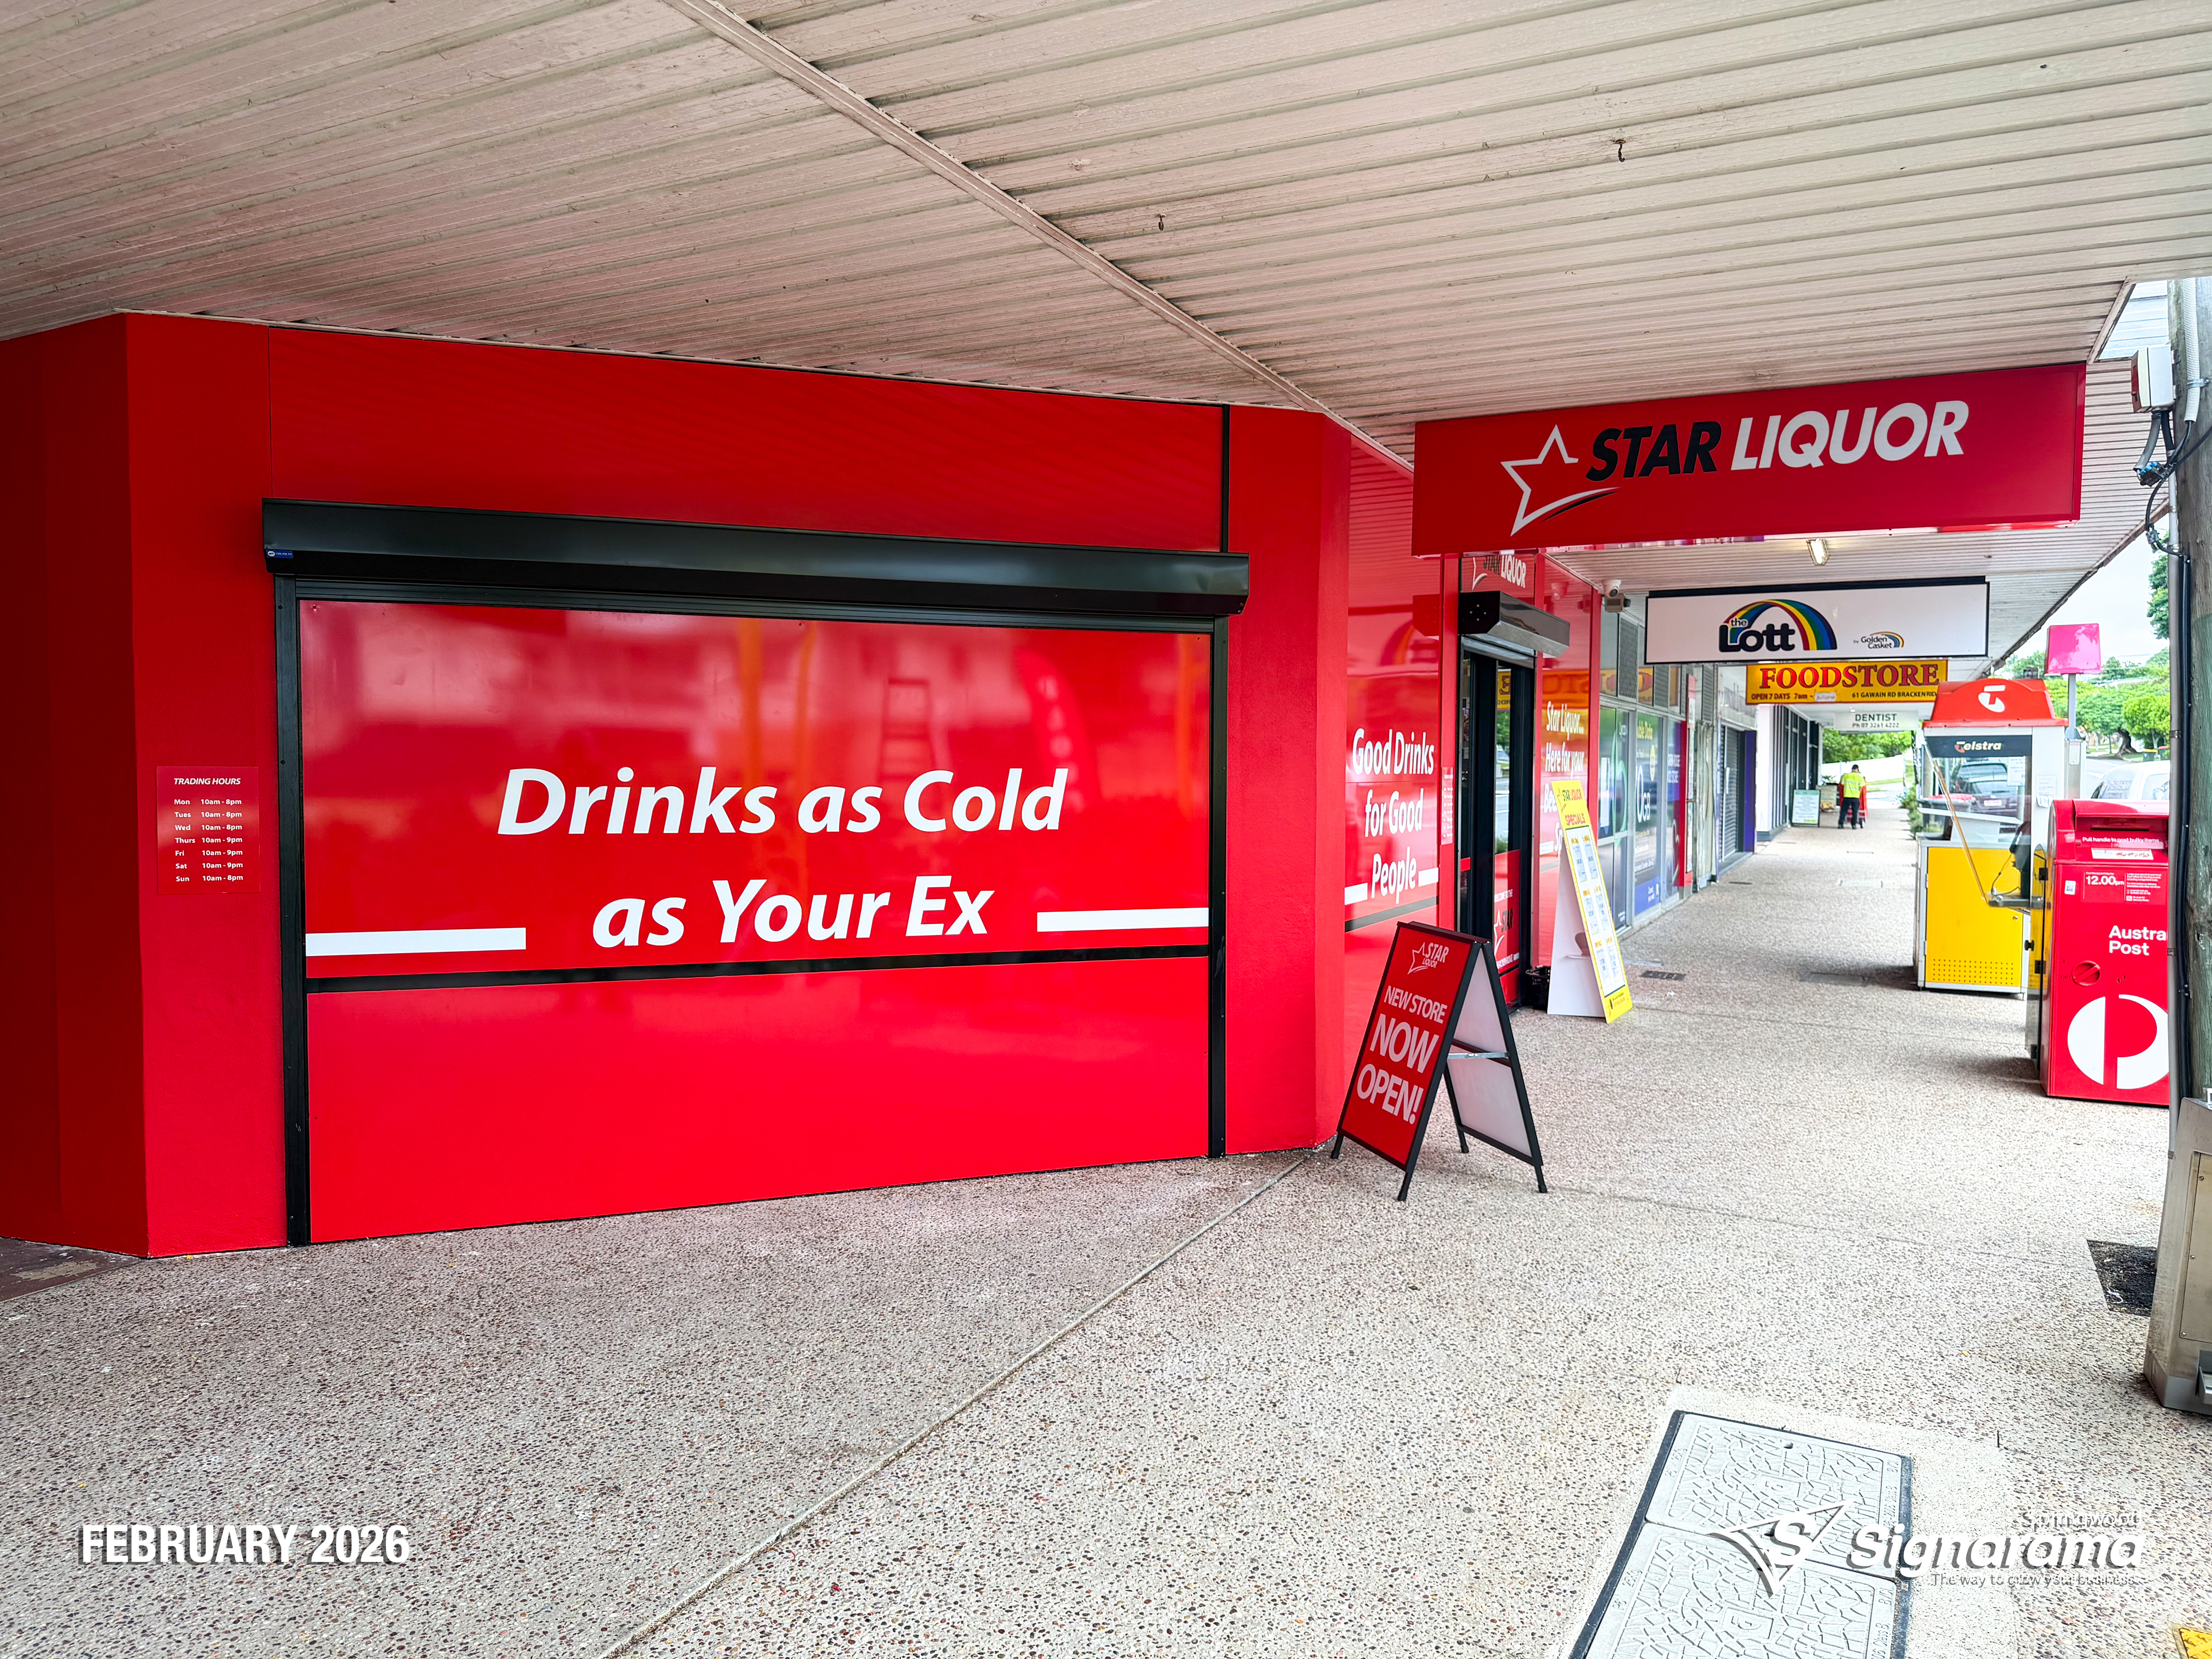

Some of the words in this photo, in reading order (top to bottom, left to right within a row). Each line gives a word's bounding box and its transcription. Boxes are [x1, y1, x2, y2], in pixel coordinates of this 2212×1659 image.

[1585, 421, 1722, 481] STAR
[1731, 400, 1968, 471] LIQUOR
[1500, 555, 1526, 589] LIQUOR
[1719, 623, 1795, 652] Lott
[1731, 618, 1747, 627] the
[1861, 636, 1887, 644] Golden
[1759, 664, 1939, 689] FOODSTORE
[1546, 701, 1560, 731] Star
[1352, 728, 1392, 775] Good
[1393, 731, 1435, 775] Drinks
[1545, 742, 1561, 772] Here
[1561, 742, 1571, 771] for
[1570, 751, 1584, 780] your
[1954, 741, 2002, 753] Telstra
[498, 766, 776, 835] Drinks
[798, 786, 882, 834] as
[904, 768, 1068, 832] Cold
[1365, 789, 1386, 837] for
[1389, 788, 1424, 834] Good
[1565, 812, 1585, 826] SPECIALS
[1371, 847, 1417, 904] People
[2086, 876, 2124, 886] 12.00pm
[593, 897, 686, 948] as
[712, 878, 890, 943] Your
[906, 876, 995, 938] Ex
[2109, 925, 2166, 941] Austra
[2109, 940, 2149, 956] Post
[1422, 957, 1437, 968] LIQUOR
[1425, 943, 1449, 963] STAR
[1384, 985, 1413, 1011] NEW
[1409, 994, 1447, 1024] STORE
[1370, 1013, 1440, 1073] NOW
[1357, 1064, 1424, 1125] OPEN!
